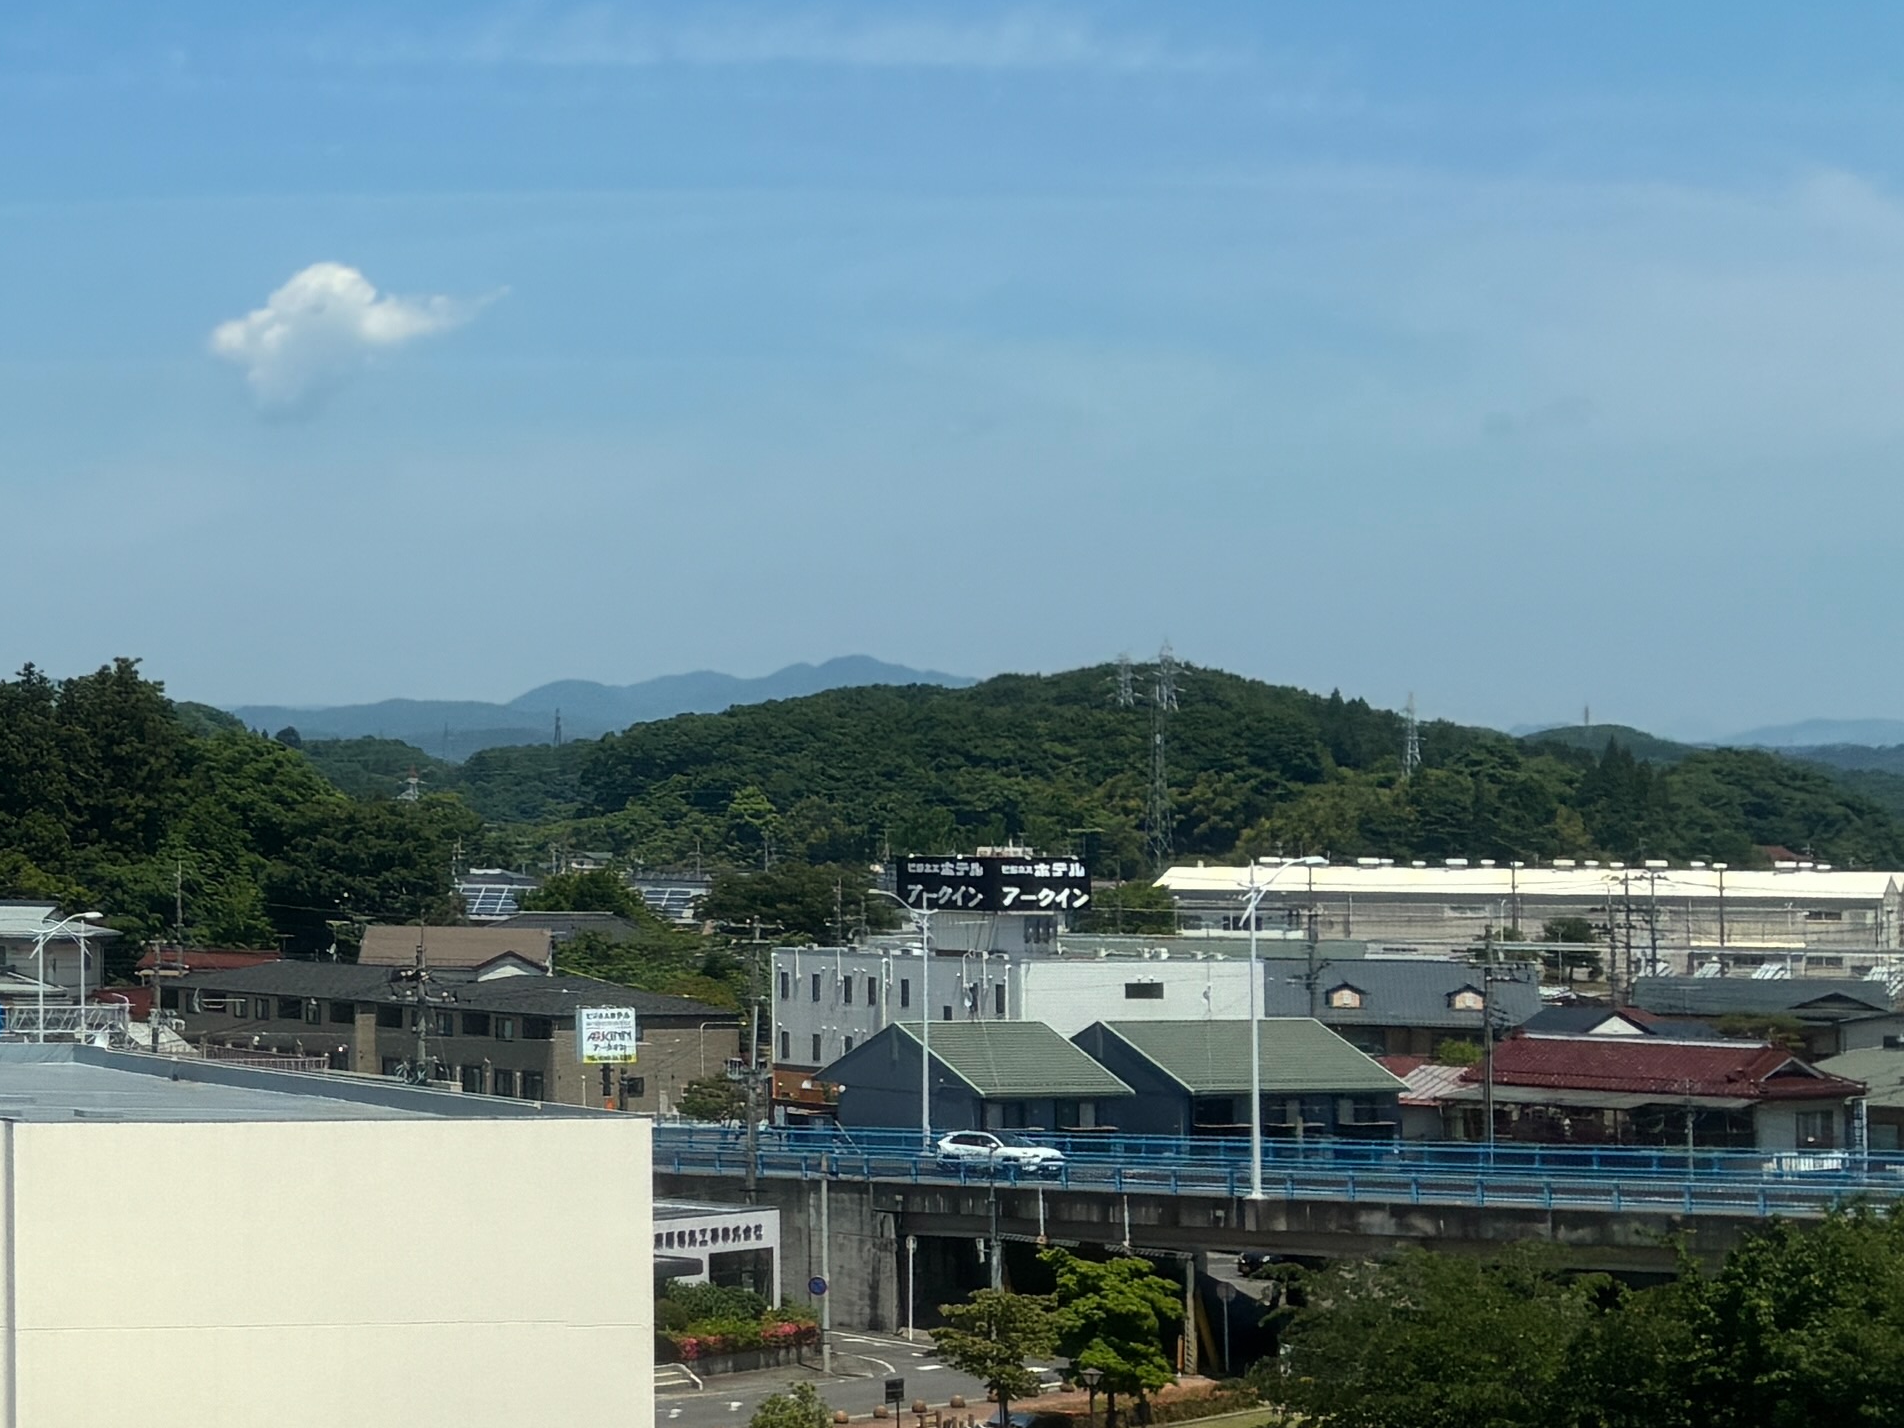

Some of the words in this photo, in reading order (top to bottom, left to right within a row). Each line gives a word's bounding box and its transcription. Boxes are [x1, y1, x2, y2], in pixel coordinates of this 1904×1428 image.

[907, 883, 984, 908] アークイン
[1002, 887, 1090, 909] アークイン
